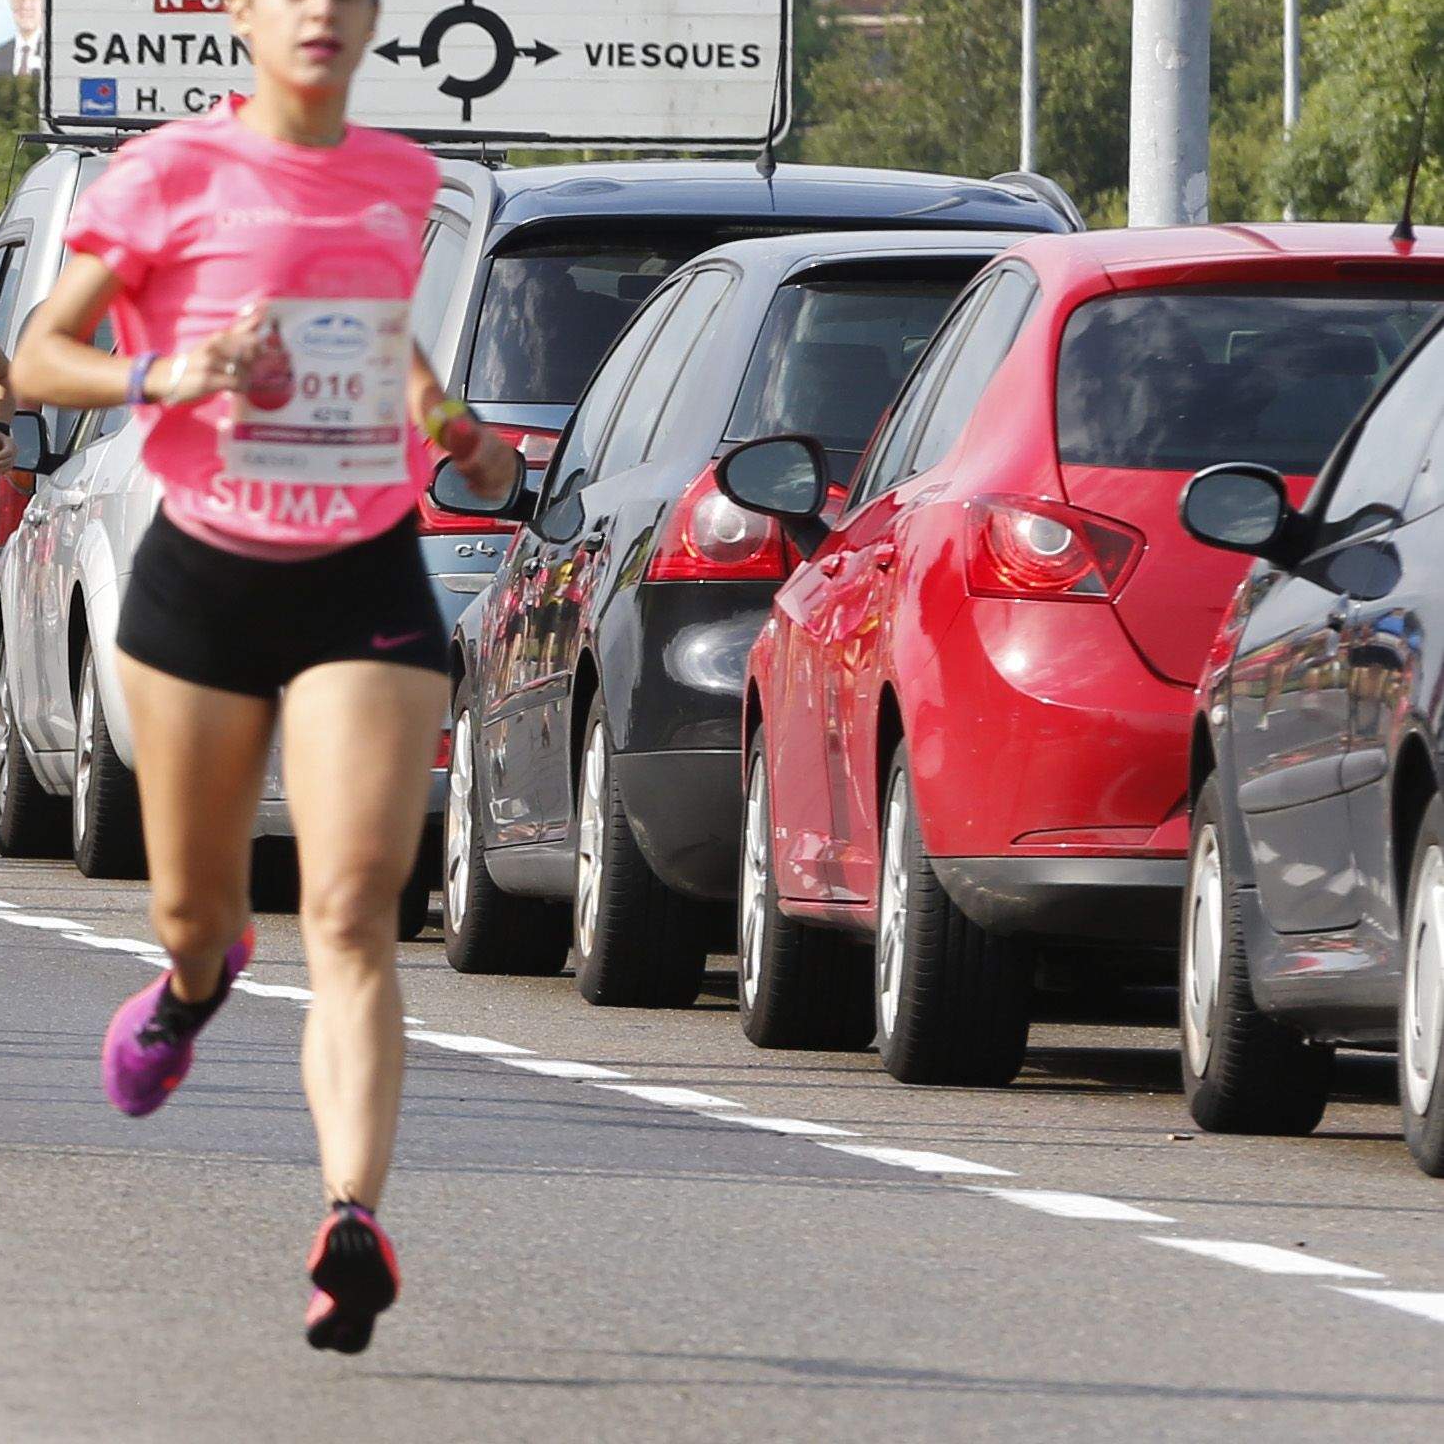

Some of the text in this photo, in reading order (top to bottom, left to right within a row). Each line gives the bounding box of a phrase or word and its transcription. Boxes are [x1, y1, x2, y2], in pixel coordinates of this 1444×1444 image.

[72, 31, 254, 65] SANTAN
[584, 42, 761, 69] VIESQUES
[136, 87, 234, 112] H. Ca
[302, 371, 364, 401] 016
[207, 472, 358, 526] SUMA
[455, 540, 497, 557] C4
